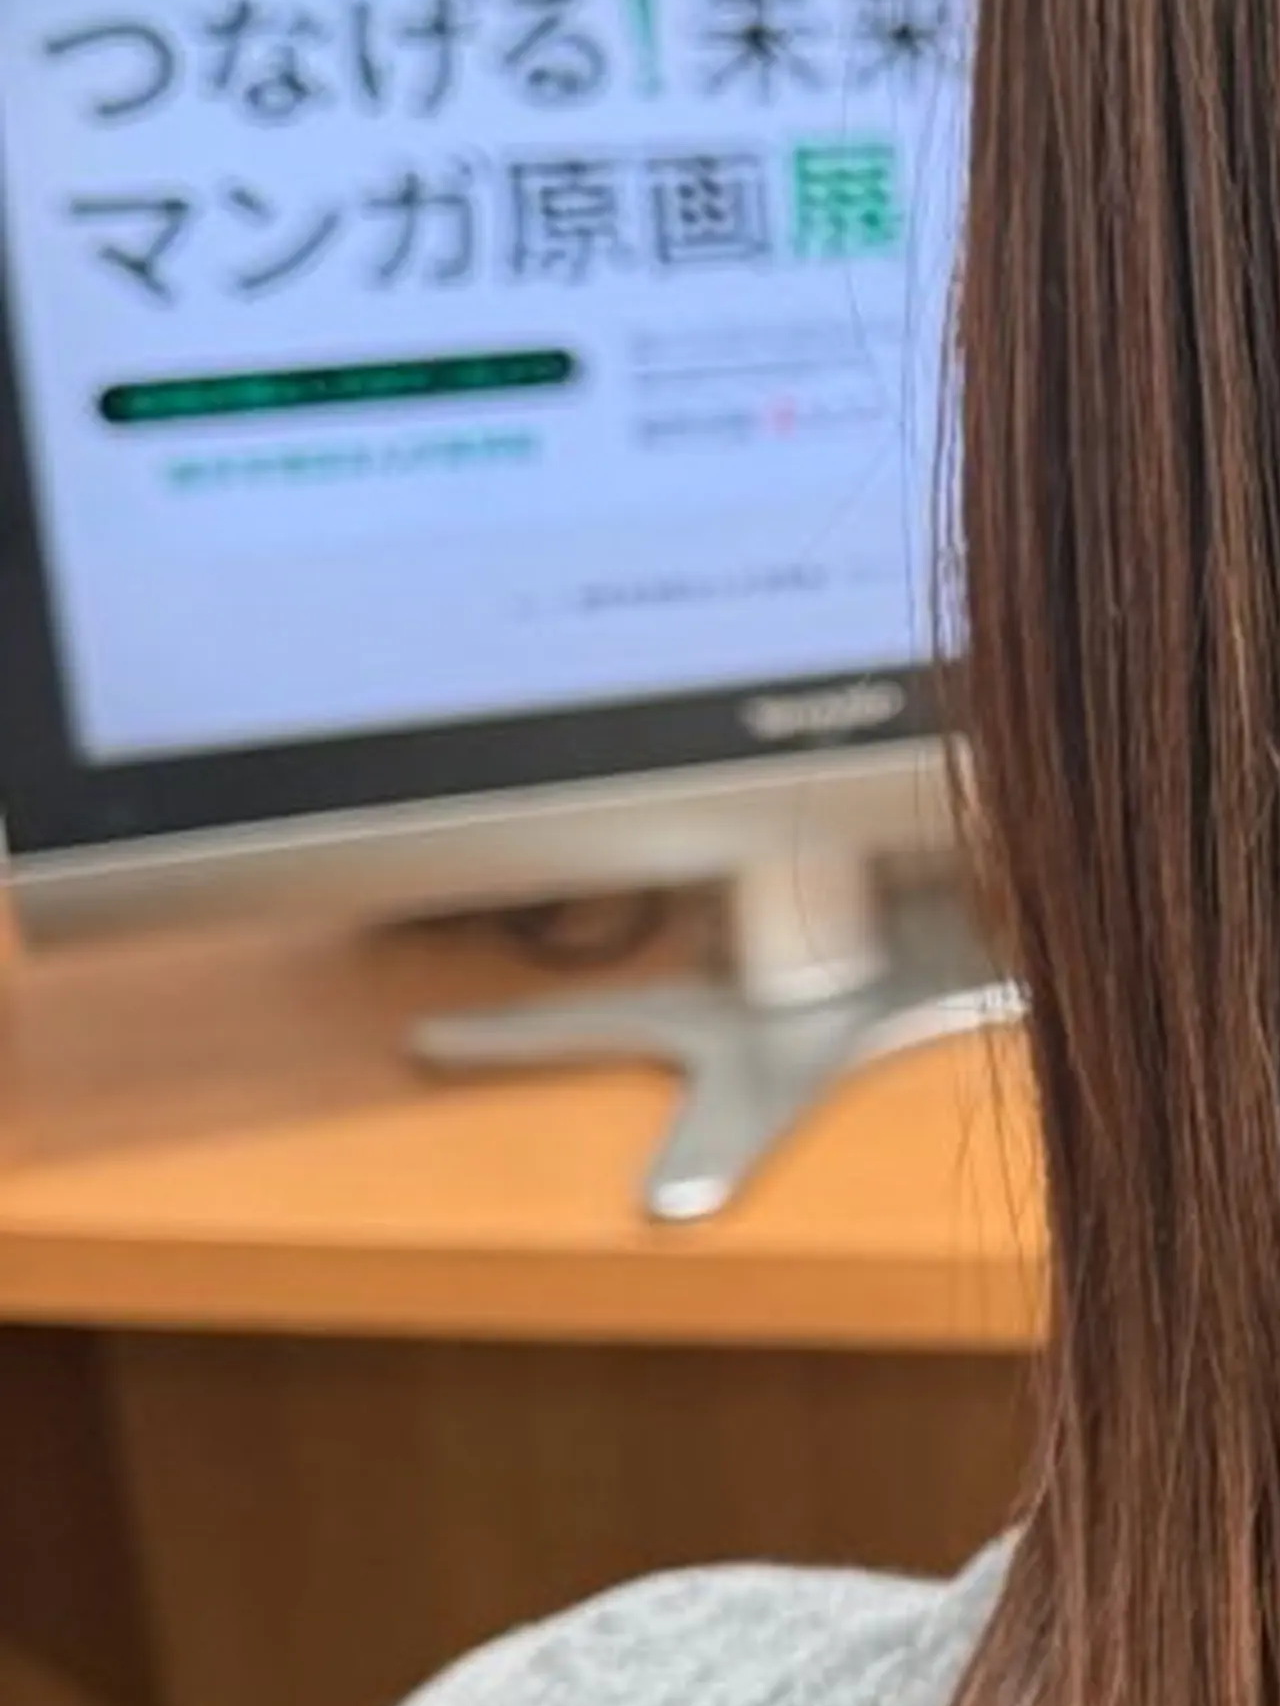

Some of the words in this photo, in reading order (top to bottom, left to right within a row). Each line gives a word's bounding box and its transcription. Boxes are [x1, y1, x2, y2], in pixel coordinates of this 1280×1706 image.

[68, 143, 904, 303] マンガ原画展
